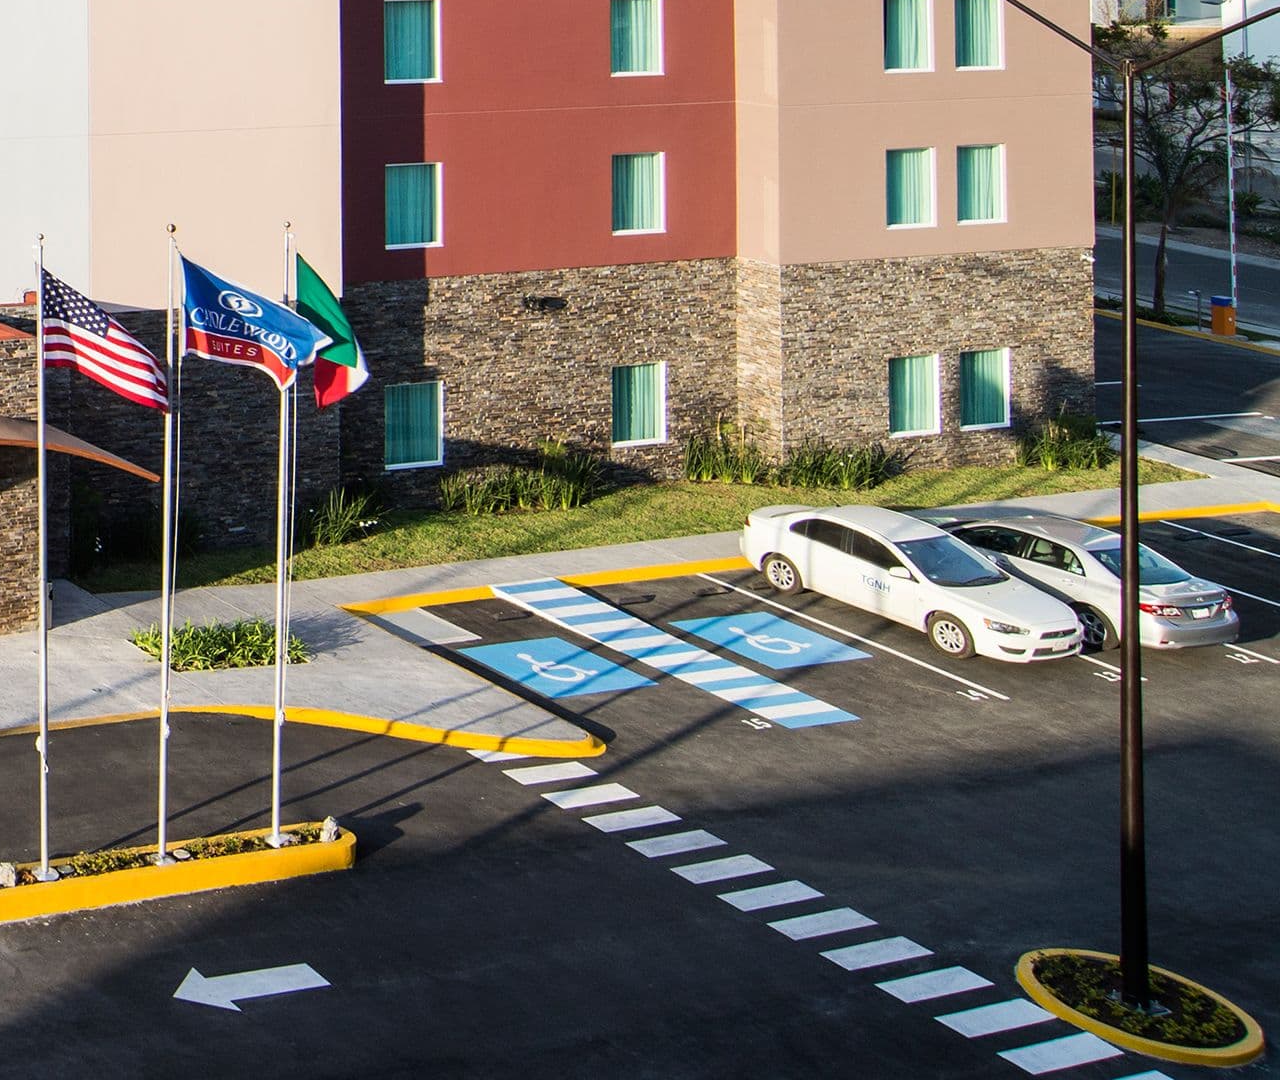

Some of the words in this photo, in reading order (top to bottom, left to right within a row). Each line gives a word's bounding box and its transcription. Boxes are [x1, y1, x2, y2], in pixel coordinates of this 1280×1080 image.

[190, 306, 297, 360] CDLEWOOD
[212, 340, 258, 356] SUITES
[862, 574, 890, 592] TGNH
[1225, 654, 1260, 664] 12
[956, 690, 989, 700] 14
[741, 718, 773, 730] 15
